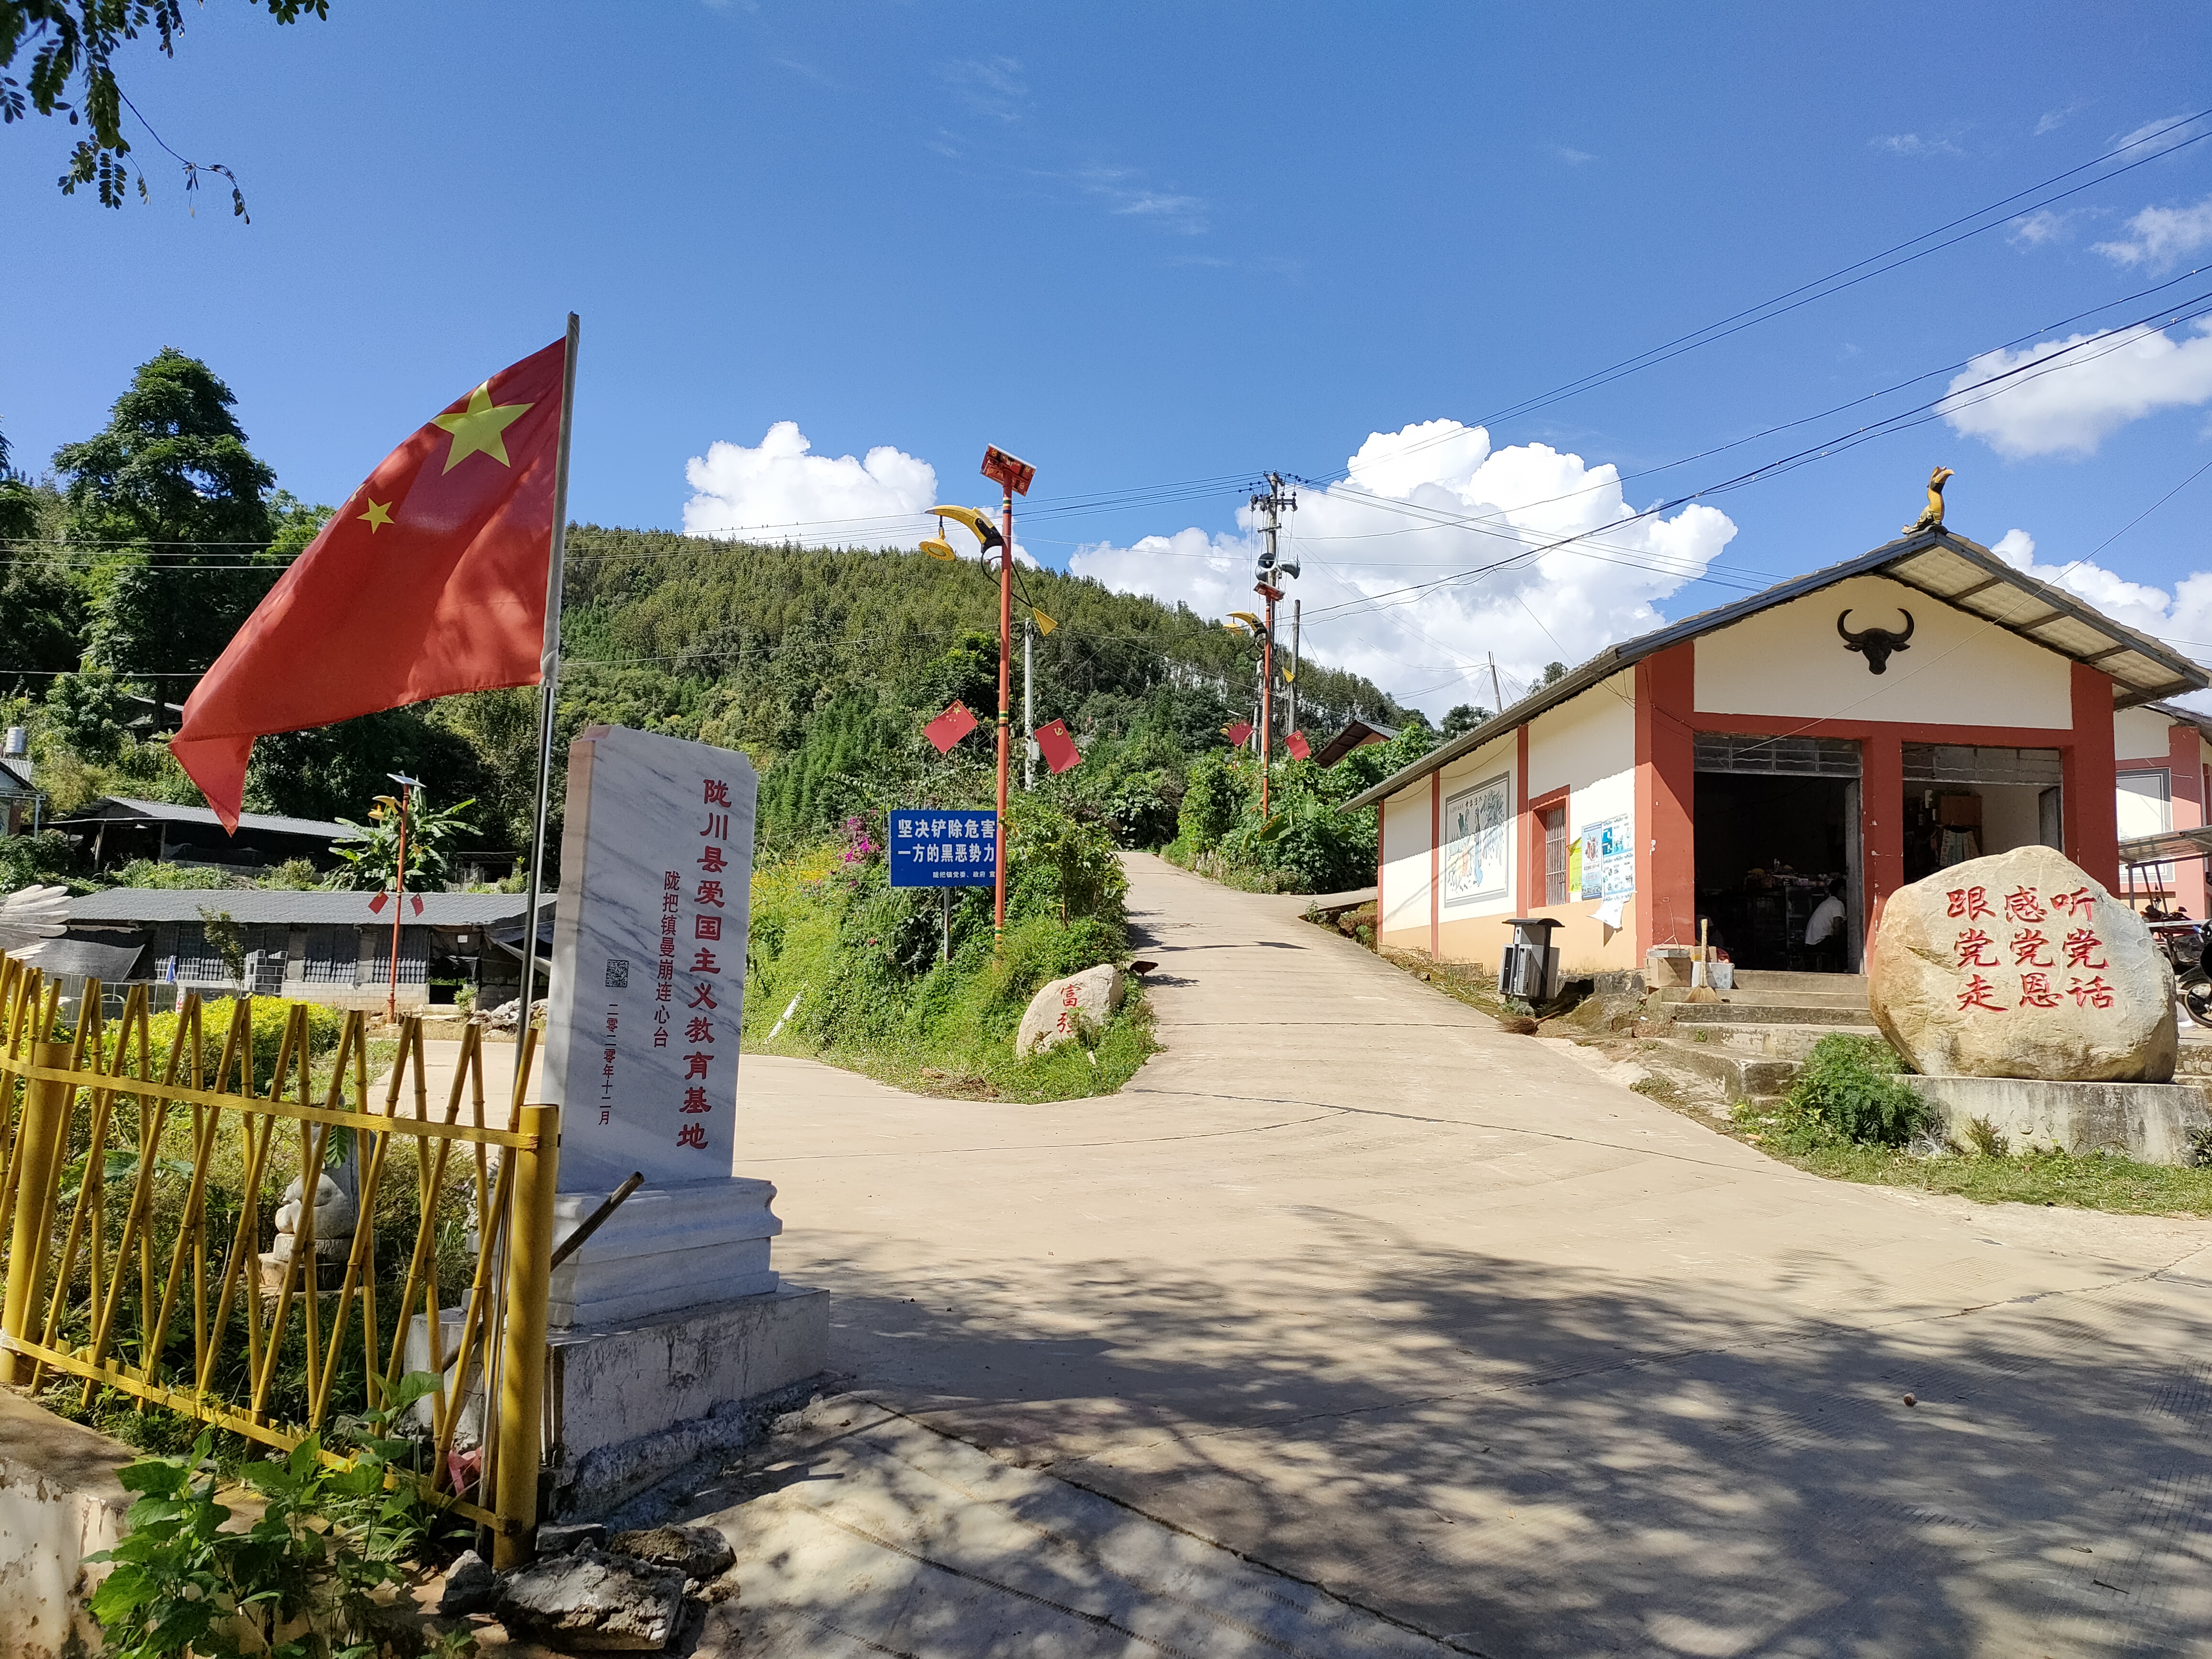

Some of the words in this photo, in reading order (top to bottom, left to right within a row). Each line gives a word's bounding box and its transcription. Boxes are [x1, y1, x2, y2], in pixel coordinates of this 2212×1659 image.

[898, 819, 995, 838] 坚决铲除危害
[898, 843, 995, 863] 一方的黑恶势力
[653, 871, 681, 1048] 陇把镇曼崩连心台
[677, 779, 732, 1150] 陇川县爱国主义教育基地
[1946, 886, 2009, 1012] 跟党走
[2004, 885, 2063, 1008] 感党恩
[2050, 887, 2115, 1009] 听党话
[598, 1004, 619, 1126] 二零二零年十二月
